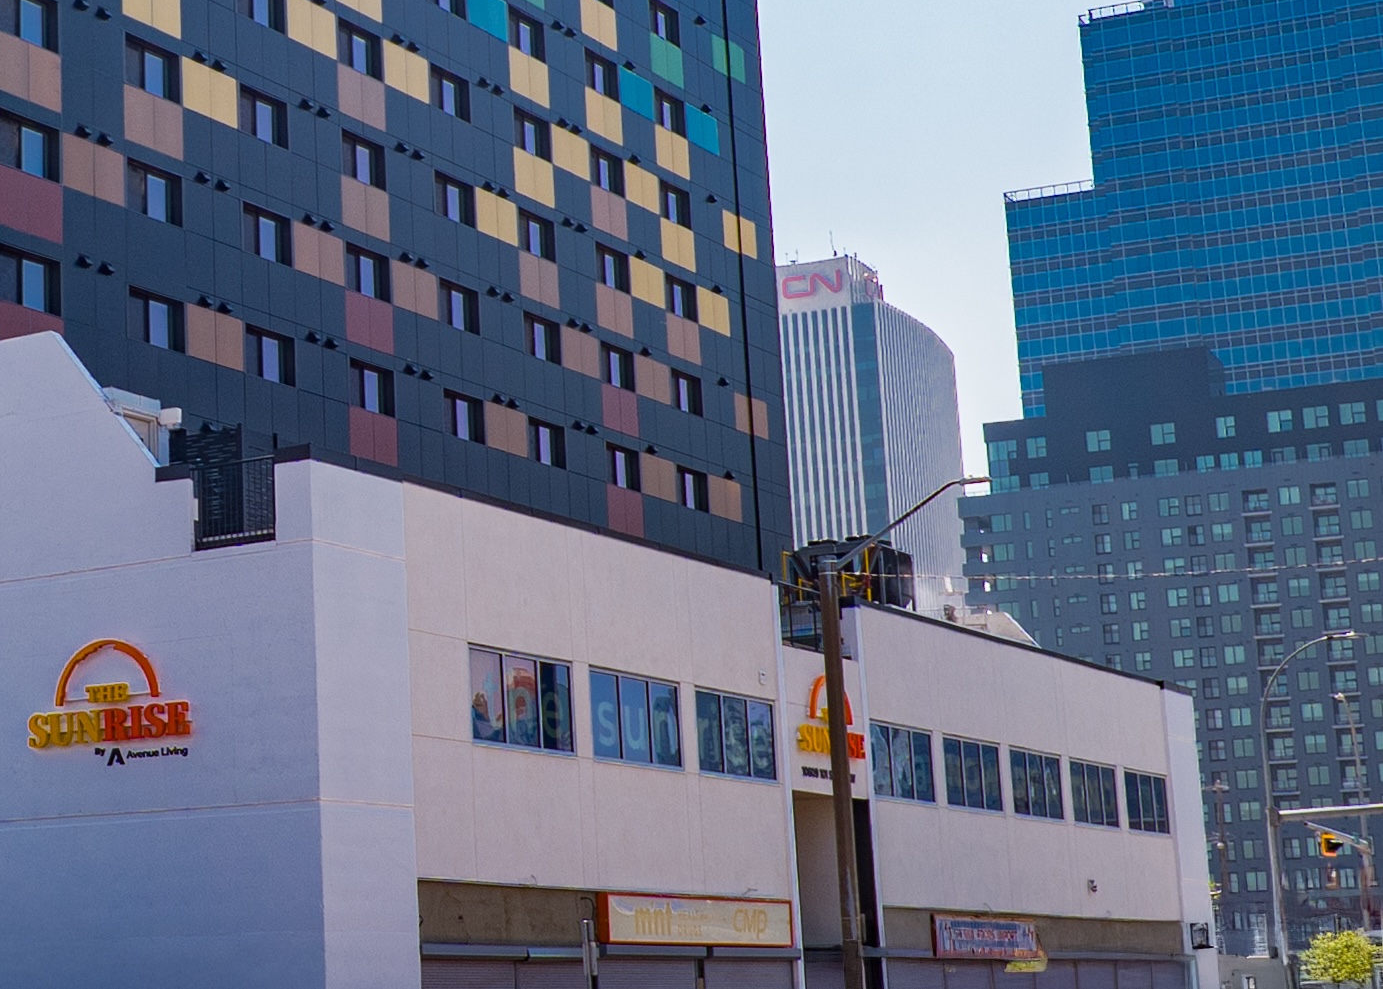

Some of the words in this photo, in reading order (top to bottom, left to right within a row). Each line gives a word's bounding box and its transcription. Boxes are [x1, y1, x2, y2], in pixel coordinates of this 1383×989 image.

[781, 269, 842, 300] CN
[85, 683, 129, 703] THE
[28, 700, 191, 749] SUNRISE
[126, 749, 160, 759] Avenue
[160, 747, 189, 758] Living
[798, 723, 866, 760] SUNSE
